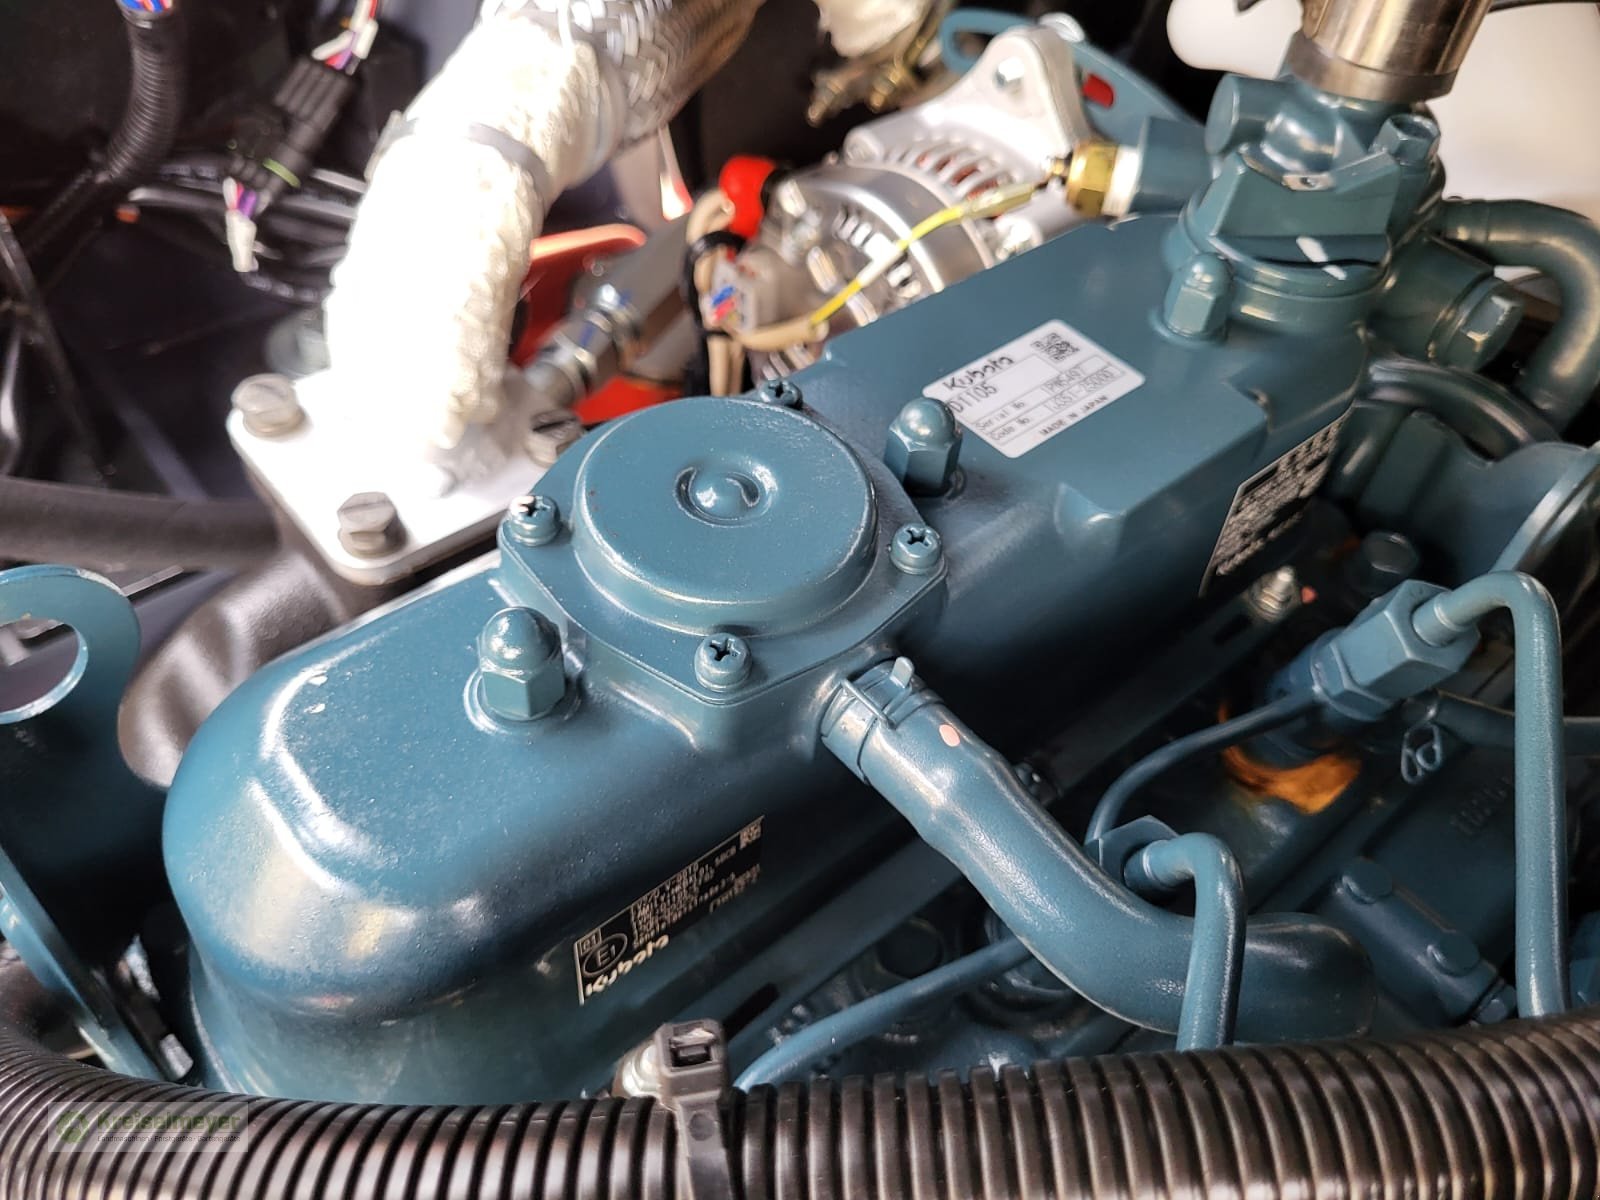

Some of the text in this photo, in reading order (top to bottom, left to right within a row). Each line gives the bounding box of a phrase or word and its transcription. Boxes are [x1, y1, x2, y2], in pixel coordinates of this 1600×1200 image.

[942, 356, 1014, 390] Kubota
[947, 381, 997, 413] D1105
[976, 409, 1009, 430] Serial
[989, 424, 1016, 441] Code
[1040, 419, 1065, 437] MADE
[1082, 395, 1109, 417] JAPAN
[585, 934, 669, 997] Kubota
